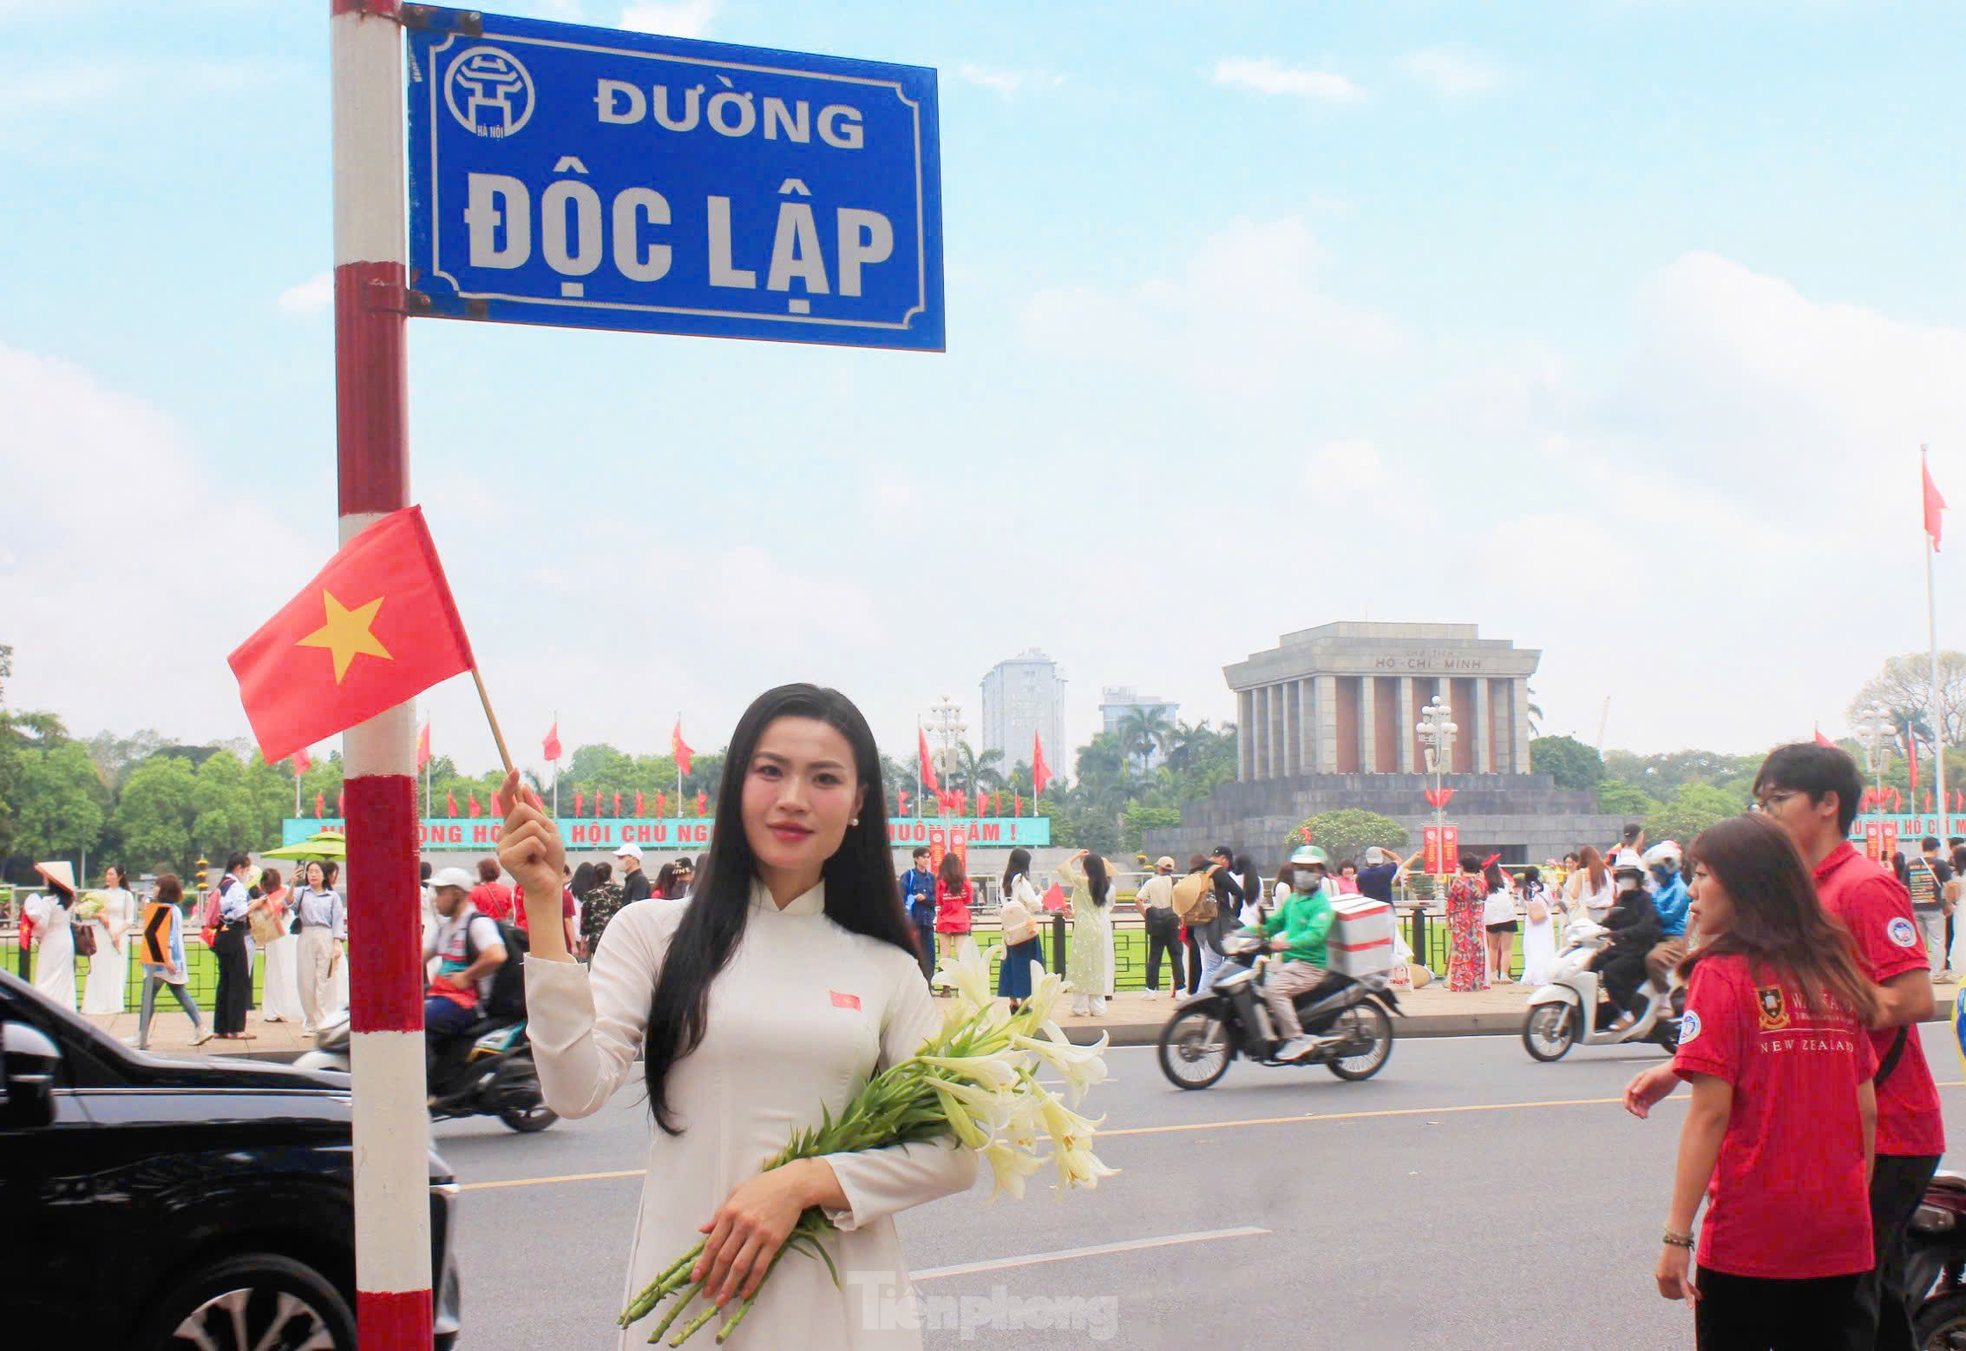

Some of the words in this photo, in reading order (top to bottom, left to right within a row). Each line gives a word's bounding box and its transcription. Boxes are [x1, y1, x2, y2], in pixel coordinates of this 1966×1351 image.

[593, 75, 864, 150] ĐƯỜNG
[464, 156, 672, 298] ĐỘC
[707, 178, 894, 315] LẬP
[416, 821, 462, 845] ỘNG
[473, 821, 503, 843] HÒ
[571, 821, 611, 846] HỘI
[621, 819, 667, 842] CHỦ
[968, 820, 1000, 841] ĂM
[1929, 815, 1950, 834] CÍ
[1761, 1040, 1795, 1053] NEW
